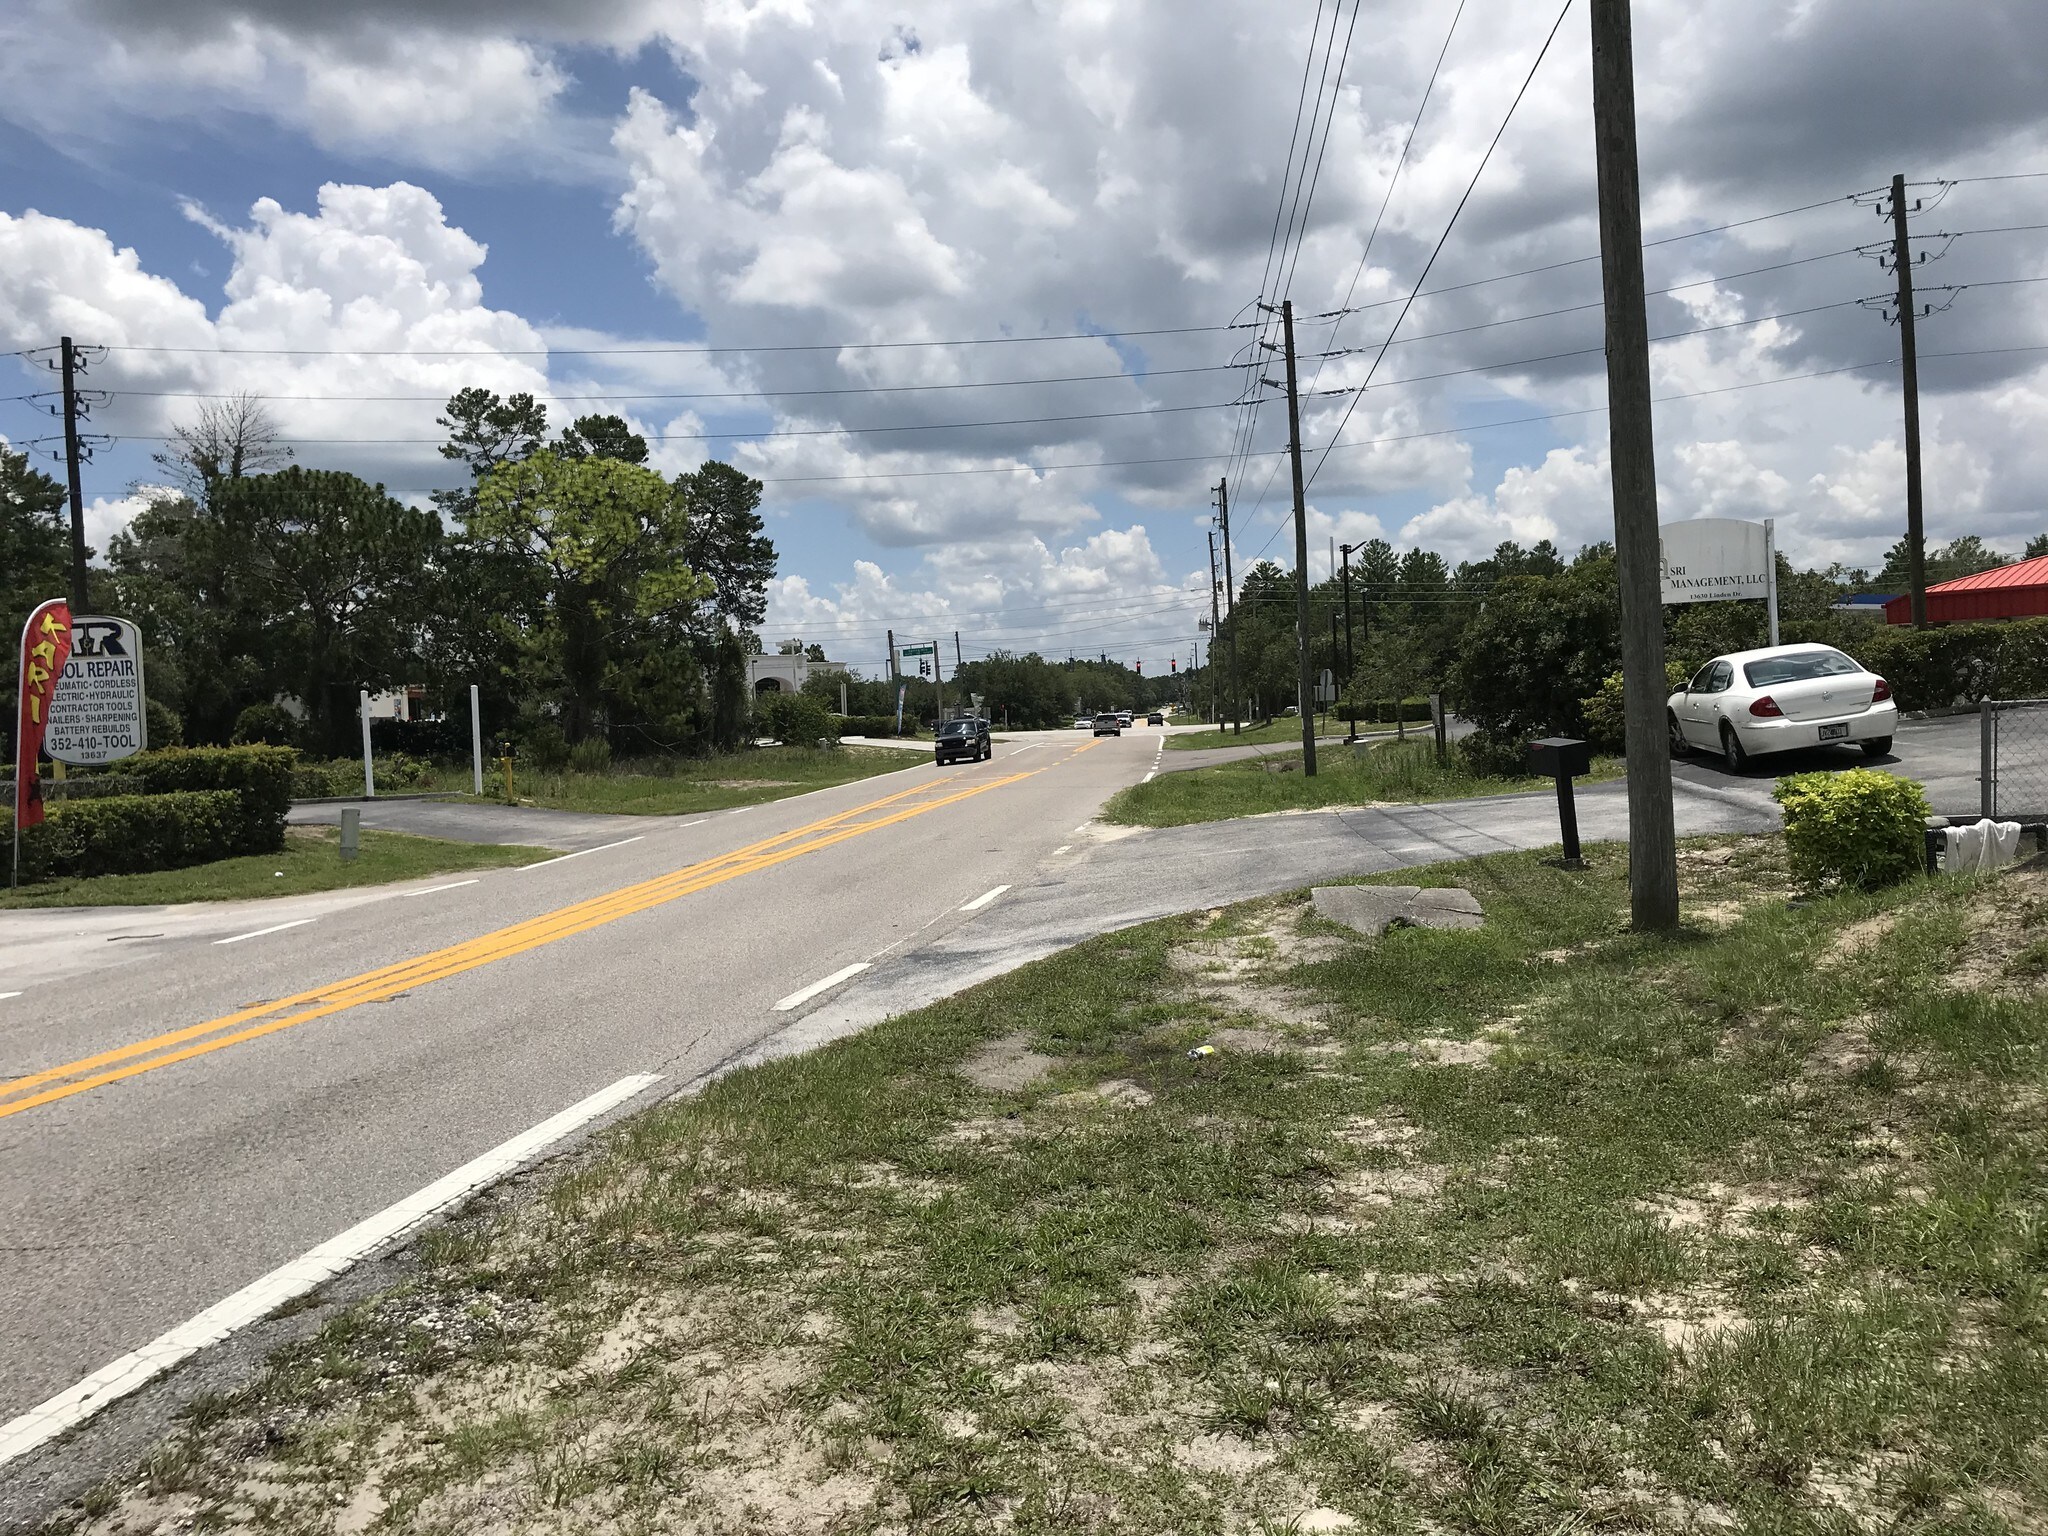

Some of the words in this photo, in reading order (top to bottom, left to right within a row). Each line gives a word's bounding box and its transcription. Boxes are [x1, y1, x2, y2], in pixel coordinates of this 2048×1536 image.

[1670, 566, 1686, 576] SRI
[1671, 575, 1744, 589] MANAGEMENT,
[1746, 573, 1766, 584] LLC
[60, 661, 84, 679] OL
[86, 659, 135, 679] REPAIR
[55, 680, 89, 691] EUMATIC
[93, 678, 136, 690] CORDLESS
[89, 689, 135, 700] HYDRAULIC
[50, 702, 105, 714] CONTRACTOR
[105, 701, 133, 712] TOOLS
[49, 715, 81, 725] NAILERS
[85, 712, 138, 723] SHARPENING
[54, 725, 90, 735] BATTERY
[92, 723, 131, 734] REBUILDS
[51, 734, 136, 751] 352-410-TOOL
[81, 750, 108, 760] 13637
